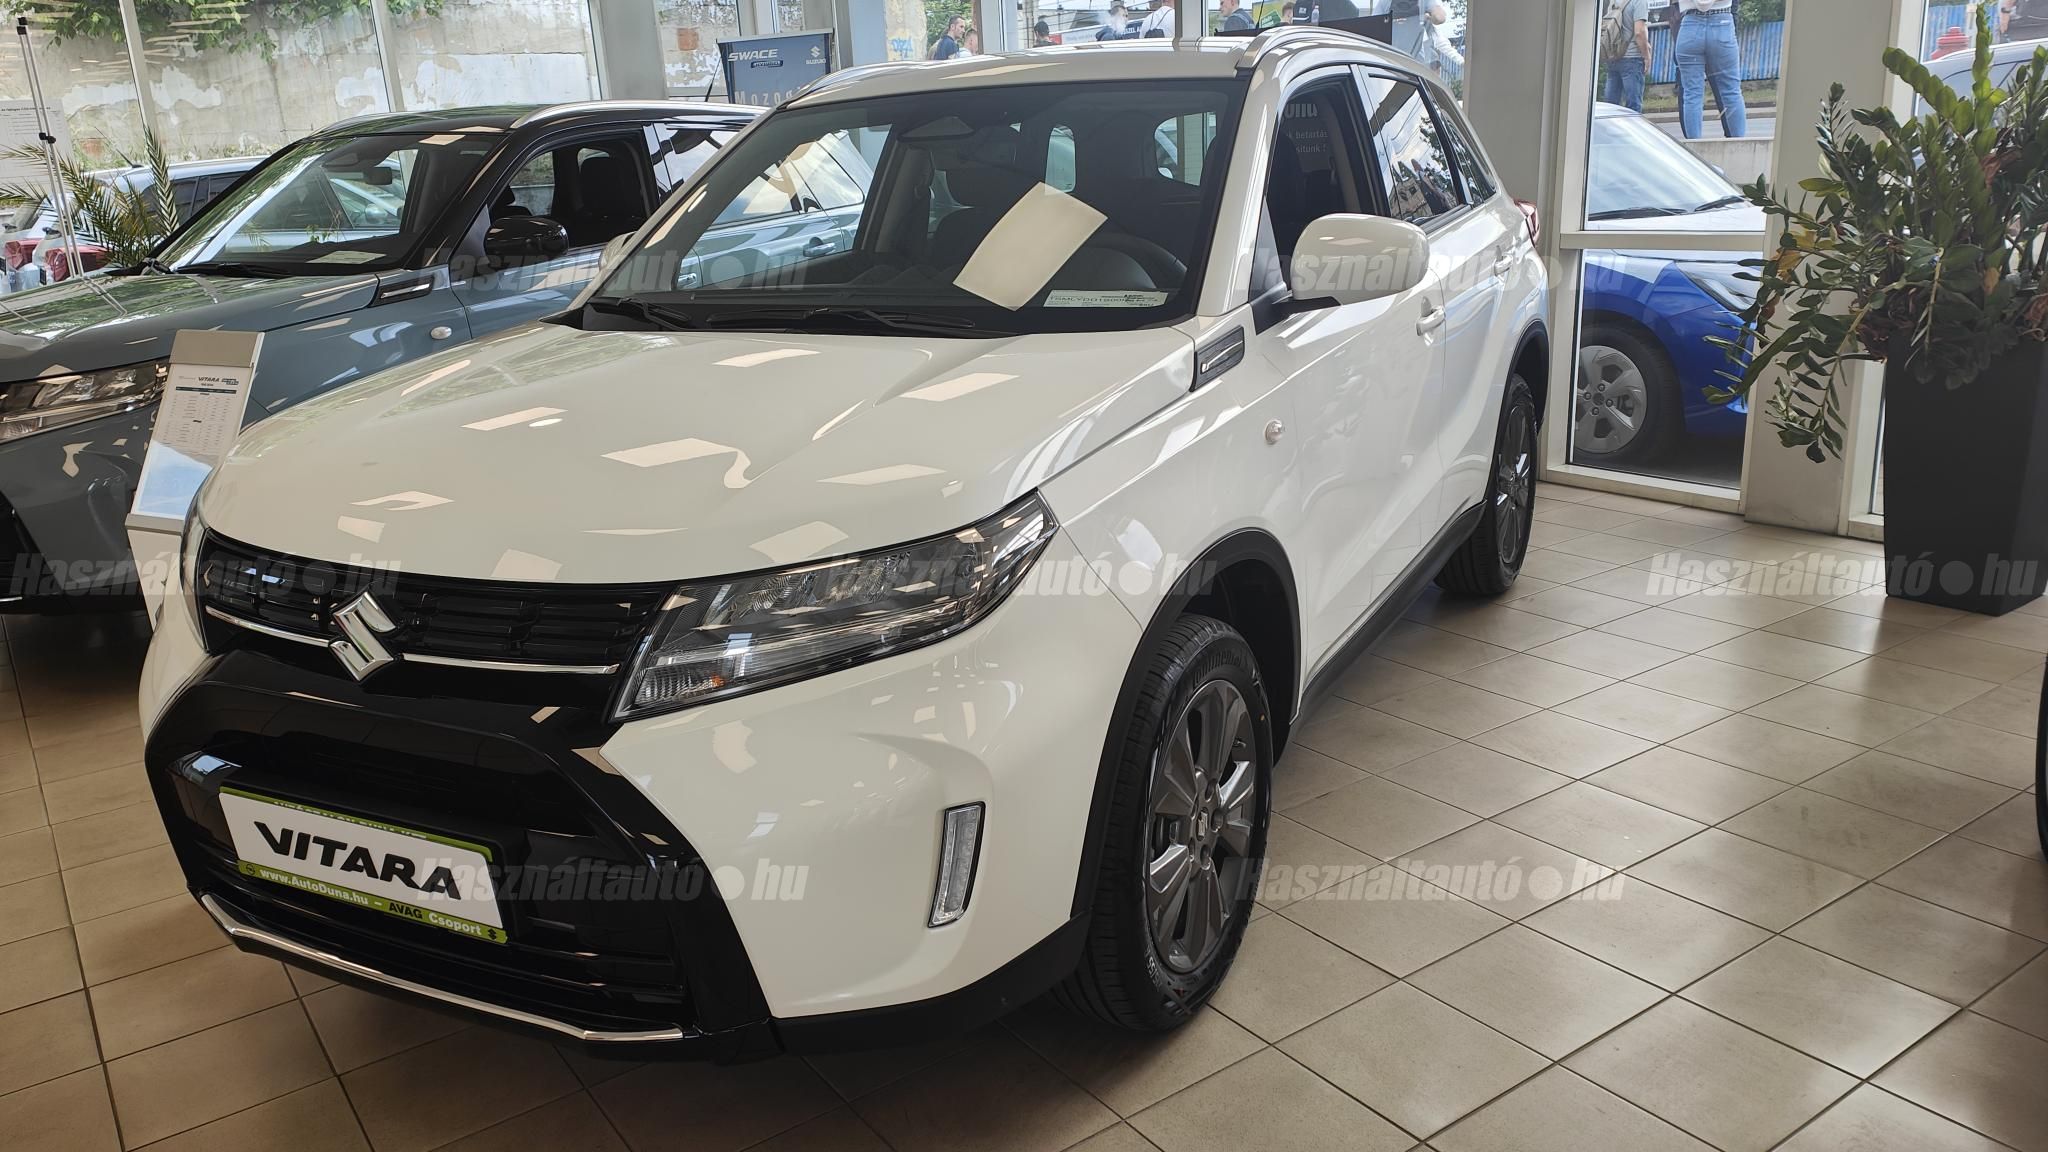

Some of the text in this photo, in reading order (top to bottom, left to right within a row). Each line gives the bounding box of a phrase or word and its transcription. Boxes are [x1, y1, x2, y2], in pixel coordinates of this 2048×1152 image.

[728, 49, 778, 62] SWACE
[254, 821, 461, 901] VITARA
[259, 868, 369, 906] www.AutoDuna.hu
[388, 901, 423, 920] AVAG
[428, 912, 482, 936] Csoport
